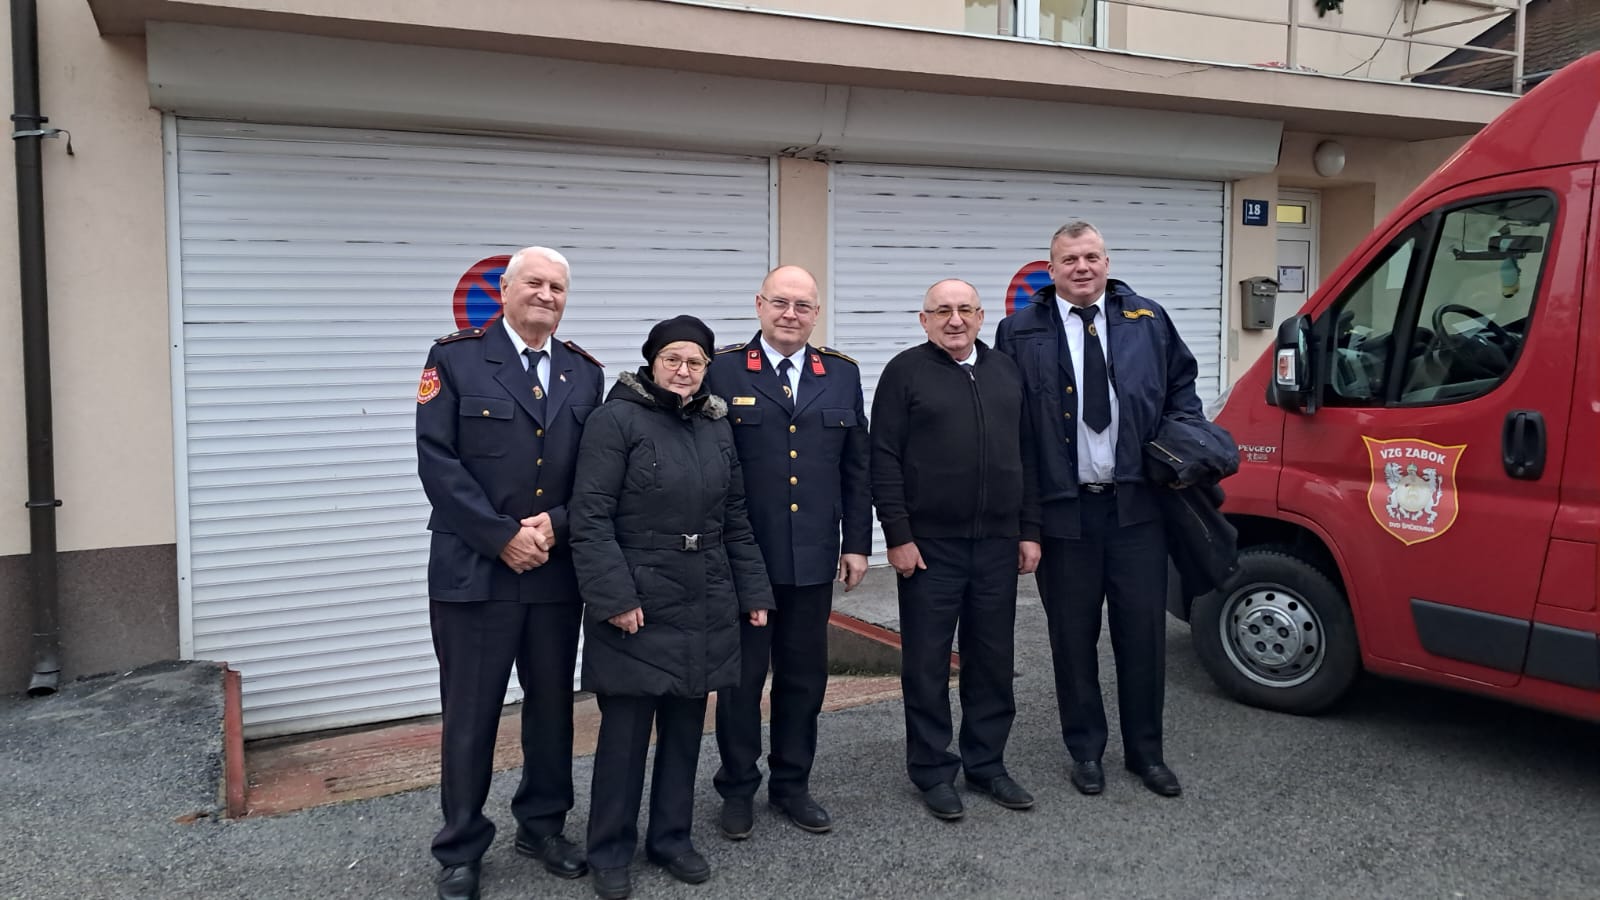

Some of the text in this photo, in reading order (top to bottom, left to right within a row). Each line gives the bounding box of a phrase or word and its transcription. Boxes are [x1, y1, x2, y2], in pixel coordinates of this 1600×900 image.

[1248, 204, 1260, 215] 18
[1238, 444, 1277, 453] PEUGEOT
[1380, 448, 1446, 465] VZG ZABOK
